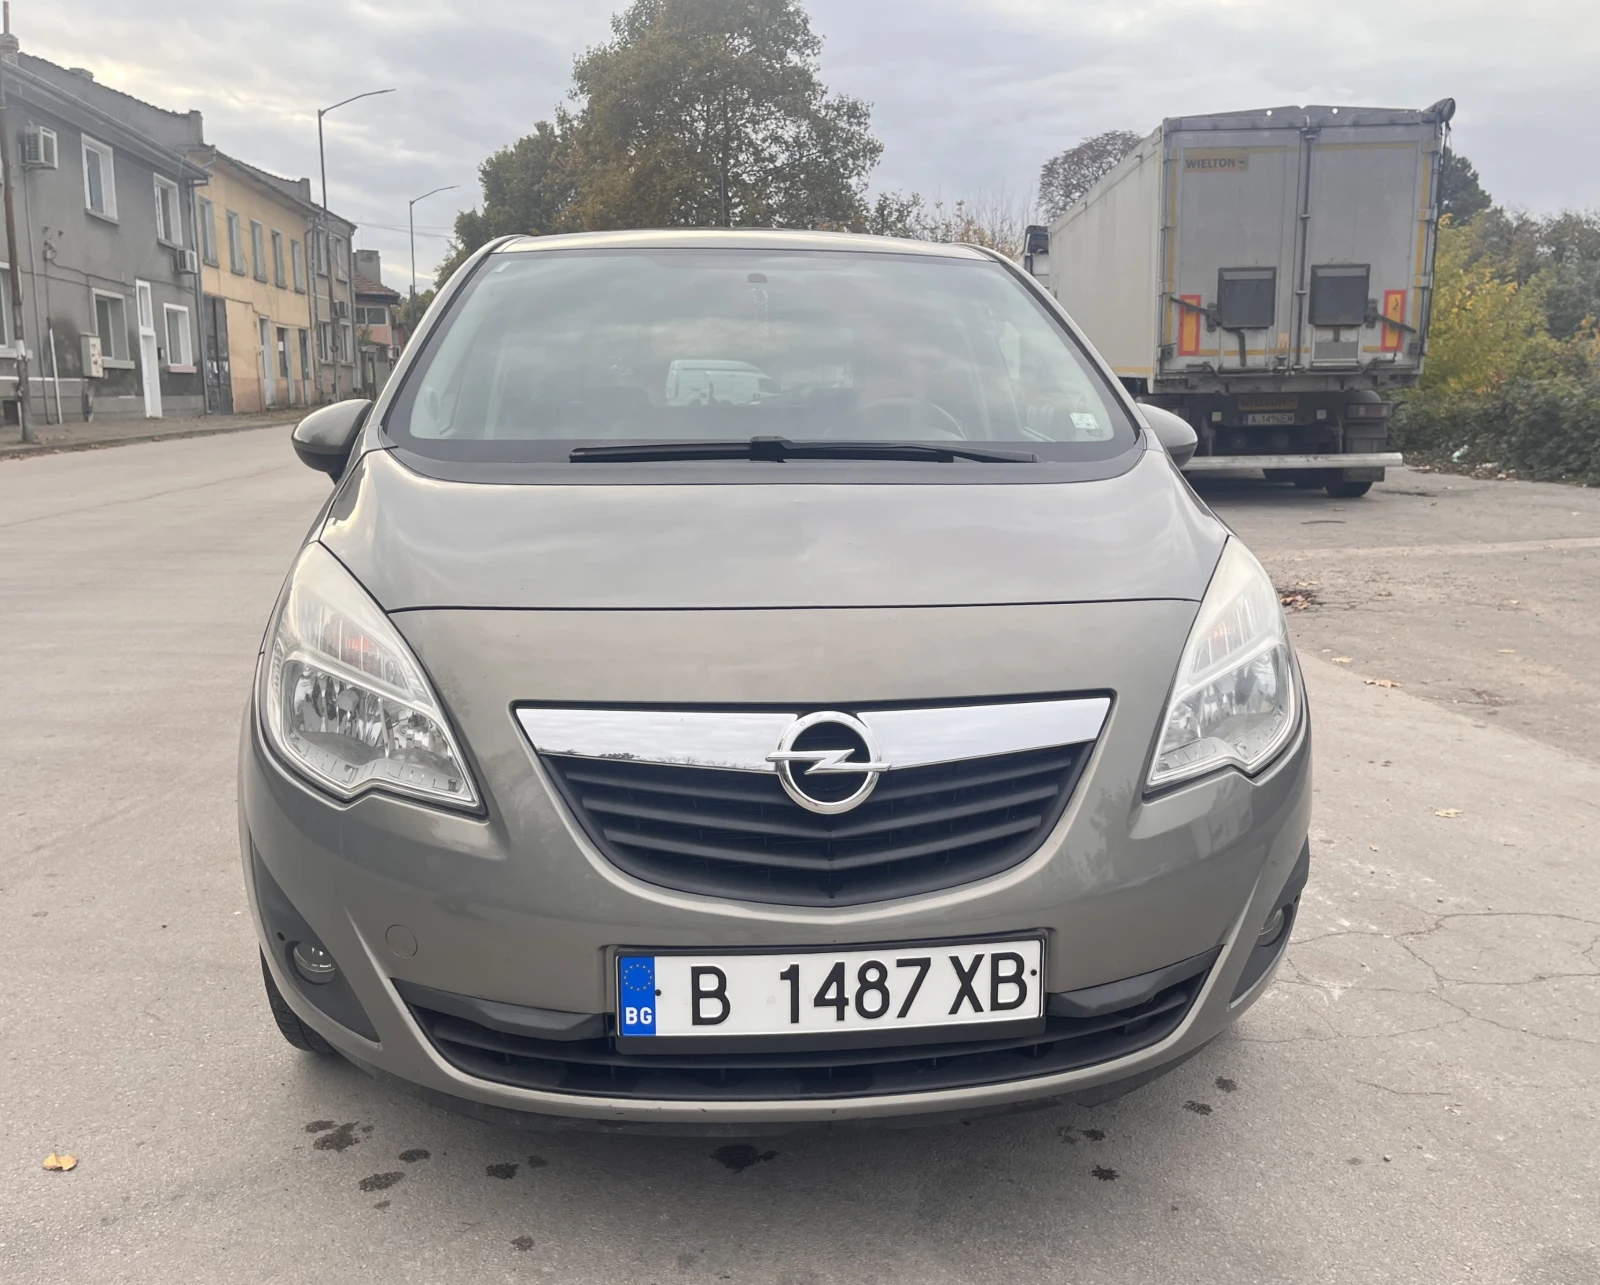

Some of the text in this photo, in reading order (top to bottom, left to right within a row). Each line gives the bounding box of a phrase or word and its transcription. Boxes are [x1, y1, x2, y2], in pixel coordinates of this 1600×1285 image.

[1185, 158, 1236, 168] WIELTON
[690, 951, 1029, 1027] B 1487 XB
[625, 1006, 653, 1025] BG
